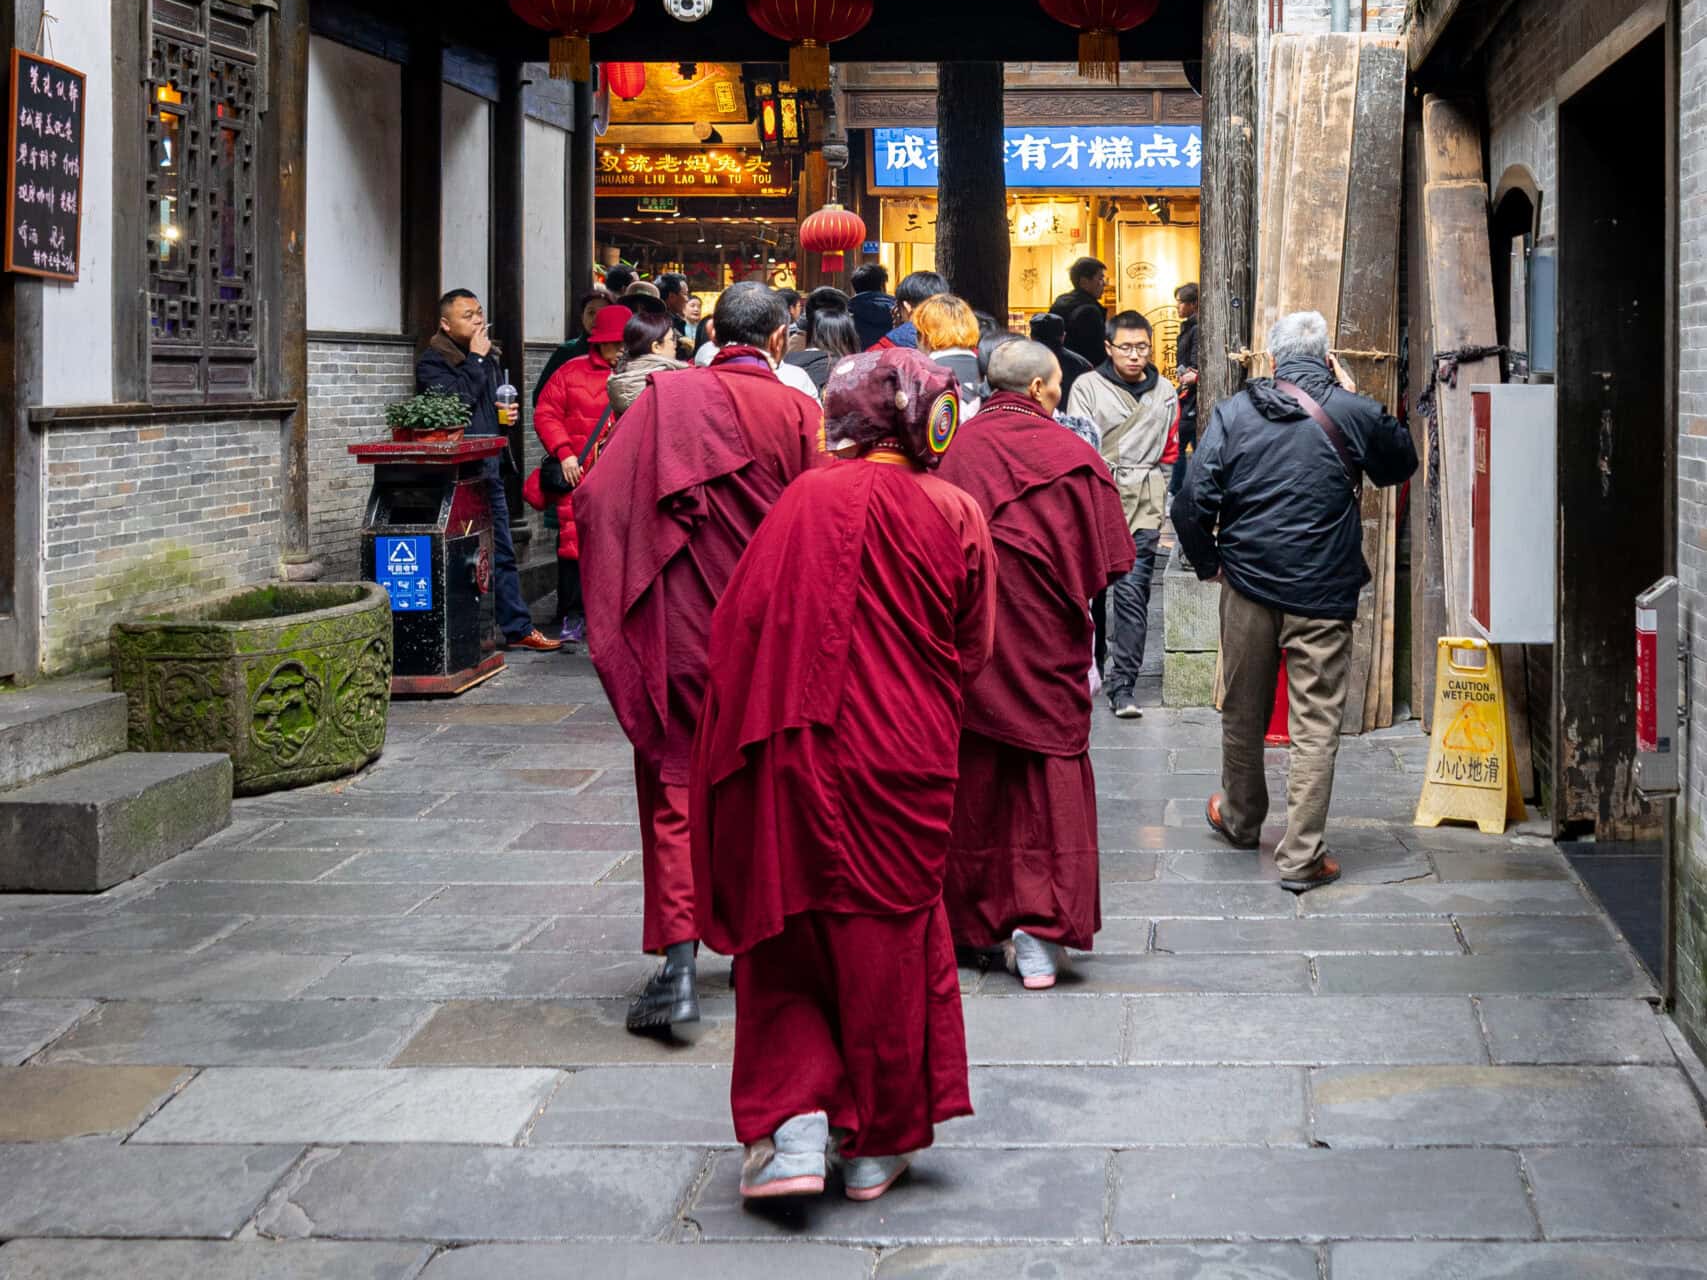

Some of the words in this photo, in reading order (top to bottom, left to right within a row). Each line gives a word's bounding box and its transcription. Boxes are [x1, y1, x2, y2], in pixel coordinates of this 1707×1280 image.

[600, 153, 771, 173] 双流老妈兔头
[645, 174, 665, 184] LIU
[675, 174, 695, 184] LAO
[704, 174, 718, 184] MA
[728, 174, 742, 184] TU
[752, 174, 772, 184] TOU
[1448, 680, 1490, 691] CAUTION
[1442, 690, 1462, 700] WET
[1464, 691, 1496, 702] FLOOR
[1435, 754, 1499, 783] 小心地滑
